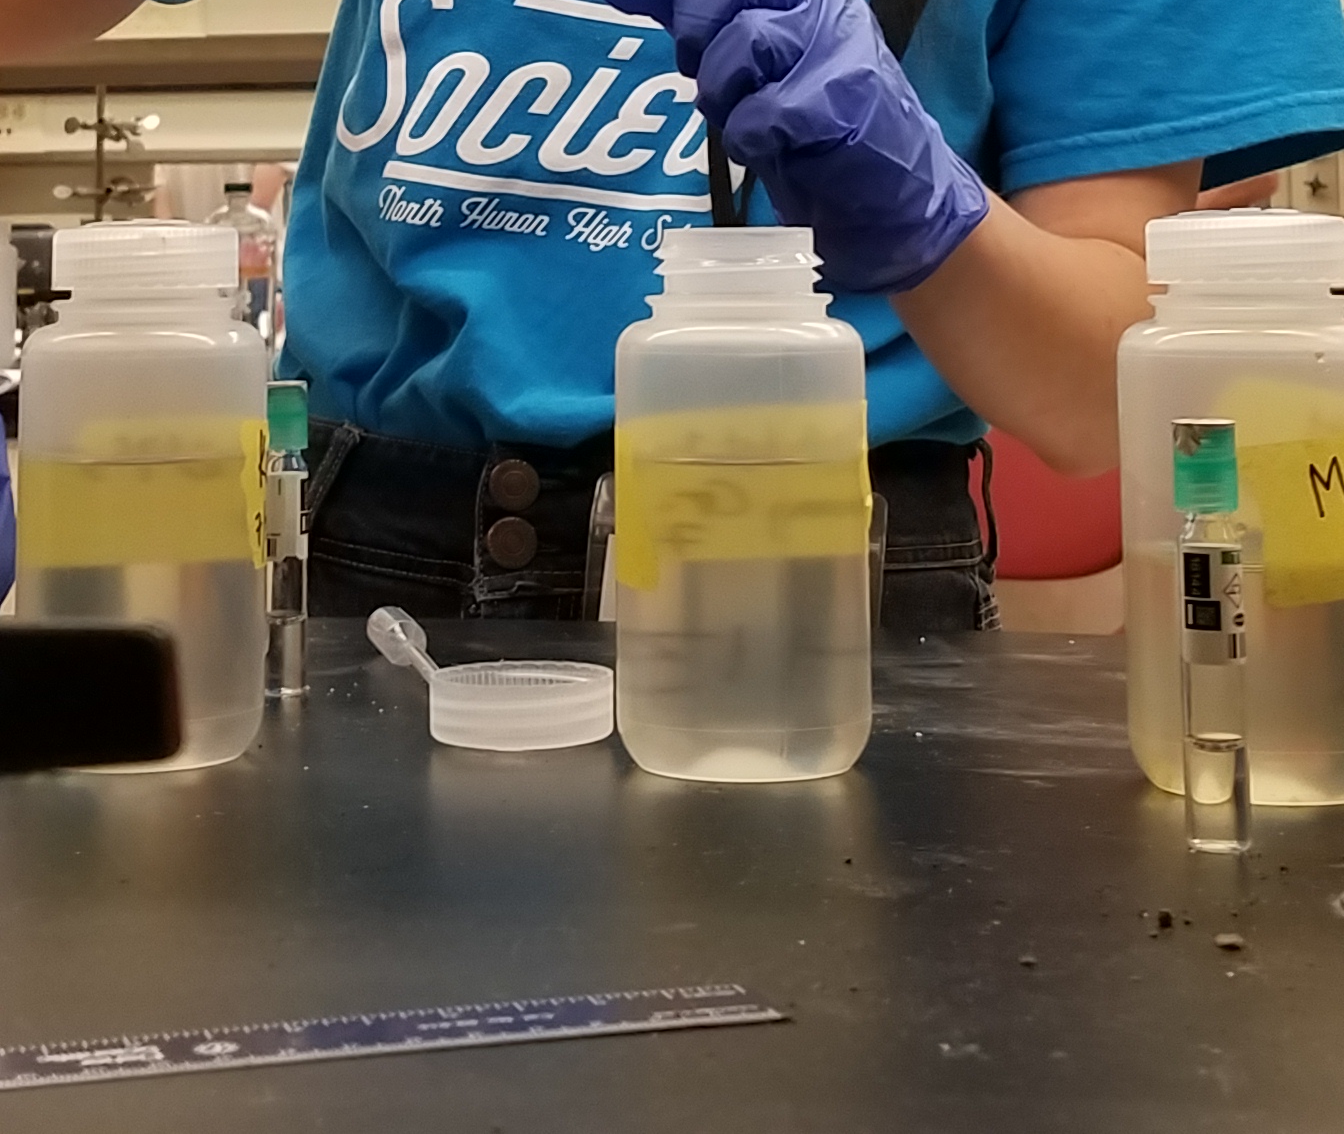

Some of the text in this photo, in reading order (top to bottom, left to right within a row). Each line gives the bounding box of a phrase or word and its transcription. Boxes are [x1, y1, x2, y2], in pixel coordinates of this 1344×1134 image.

[378, 184, 445, 228] North
[459, 196, 551, 237] Huron
[564, 206, 633, 252] High
